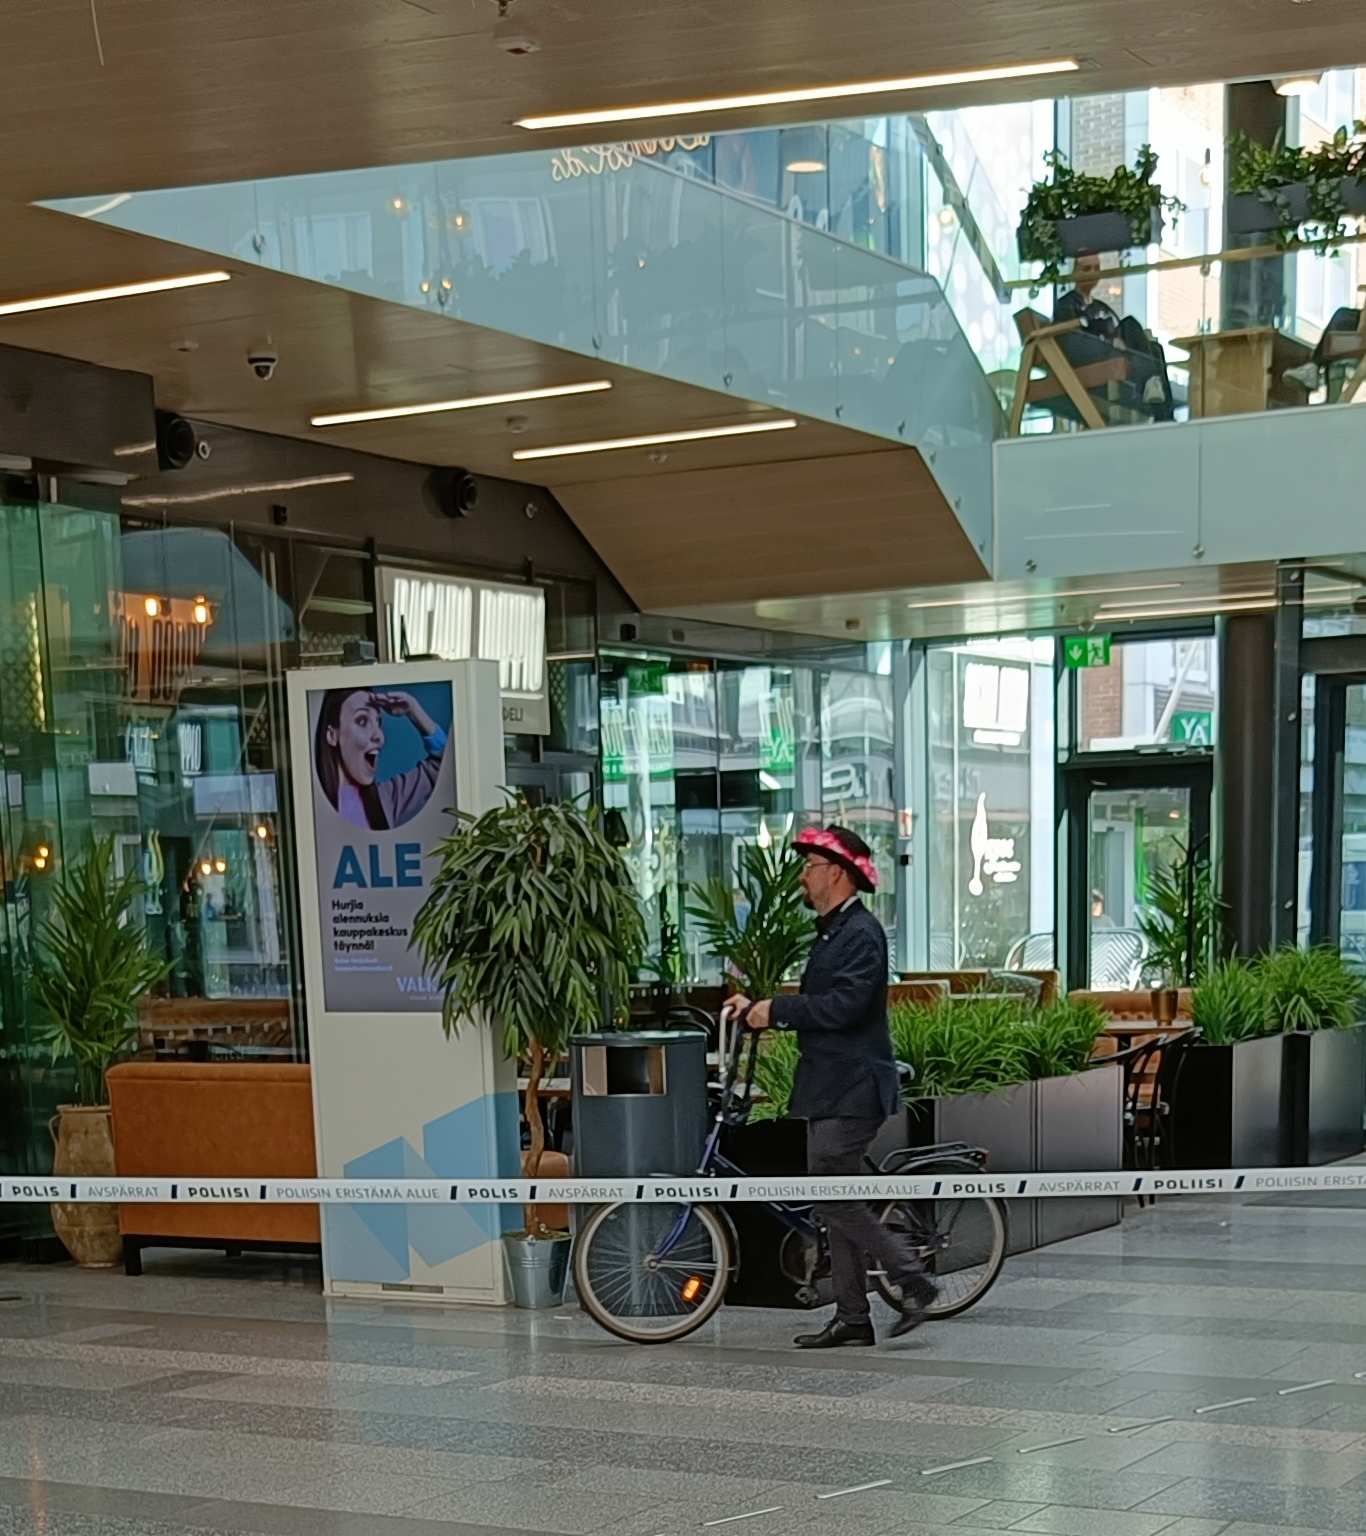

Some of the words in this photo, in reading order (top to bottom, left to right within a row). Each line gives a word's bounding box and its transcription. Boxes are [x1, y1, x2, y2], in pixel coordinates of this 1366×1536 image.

[332, 843, 423, 889] ALE
[332, 899, 364, 912] Hurjia
[333, 912, 389, 924] alennuksia
[333, 927, 408, 940] kauppakeskus
[334, 940, 375, 953] täynnä!
[396, 975, 451, 992] VALK
[12, 1185, 60, 1197] POLIS
[88, 1183, 159, 1198] AVSPÄRRAT
[188, 1186, 250, 1199] POLIISI
[276, 1186, 331, 1199] POLIISIN
[335, 1184, 403, 1199] ERISTÄMÄ
[407, 1186, 440, 1199] ALUE
[468, 1187, 519, 1199] POLIS
[548, 1184, 624, 1199] AVSPÄRRAT
[655, 1186, 719, 1198] POLIISI
[748, 1185, 806, 1197] POLIISIN
[810, 1182, 882, 1196] ERISTÄMÄ
[885, 1183, 921, 1195] ALUE
[953, 1182, 1006, 1194] POLIS
[1038, 1178, 1121, 1192] AVSPÄRRAT
[1154, 1178, 1223, 1190] POLIISI
[1255, 1175, 1318, 1188] POLIISIN
